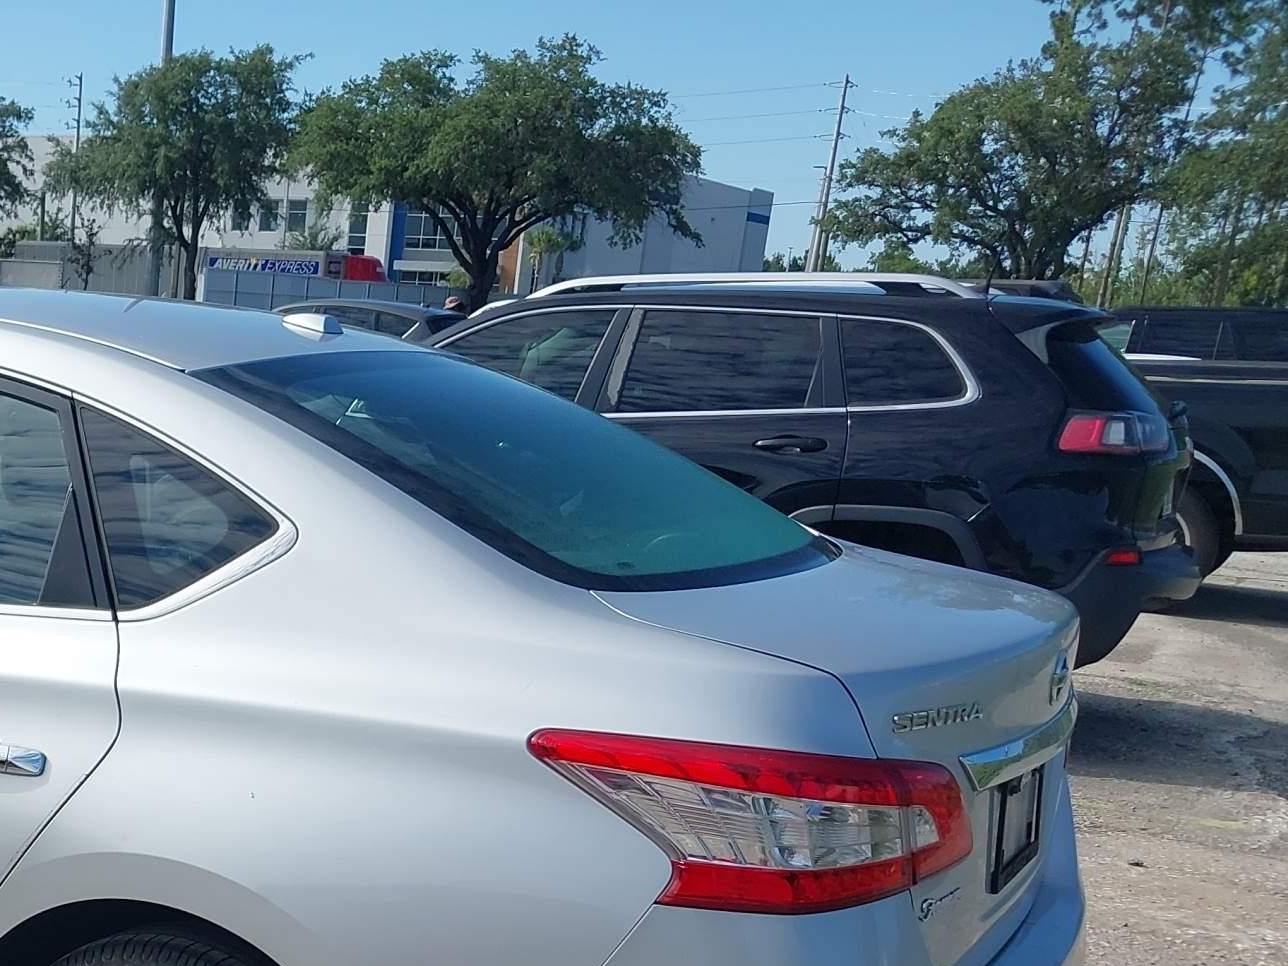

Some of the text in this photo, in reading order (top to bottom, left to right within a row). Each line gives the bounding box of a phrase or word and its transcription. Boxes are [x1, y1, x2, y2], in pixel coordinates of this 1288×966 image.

[214, 257, 316, 275] AVERITT EXPRESS
[893, 703, 984, 734] SENTRA
